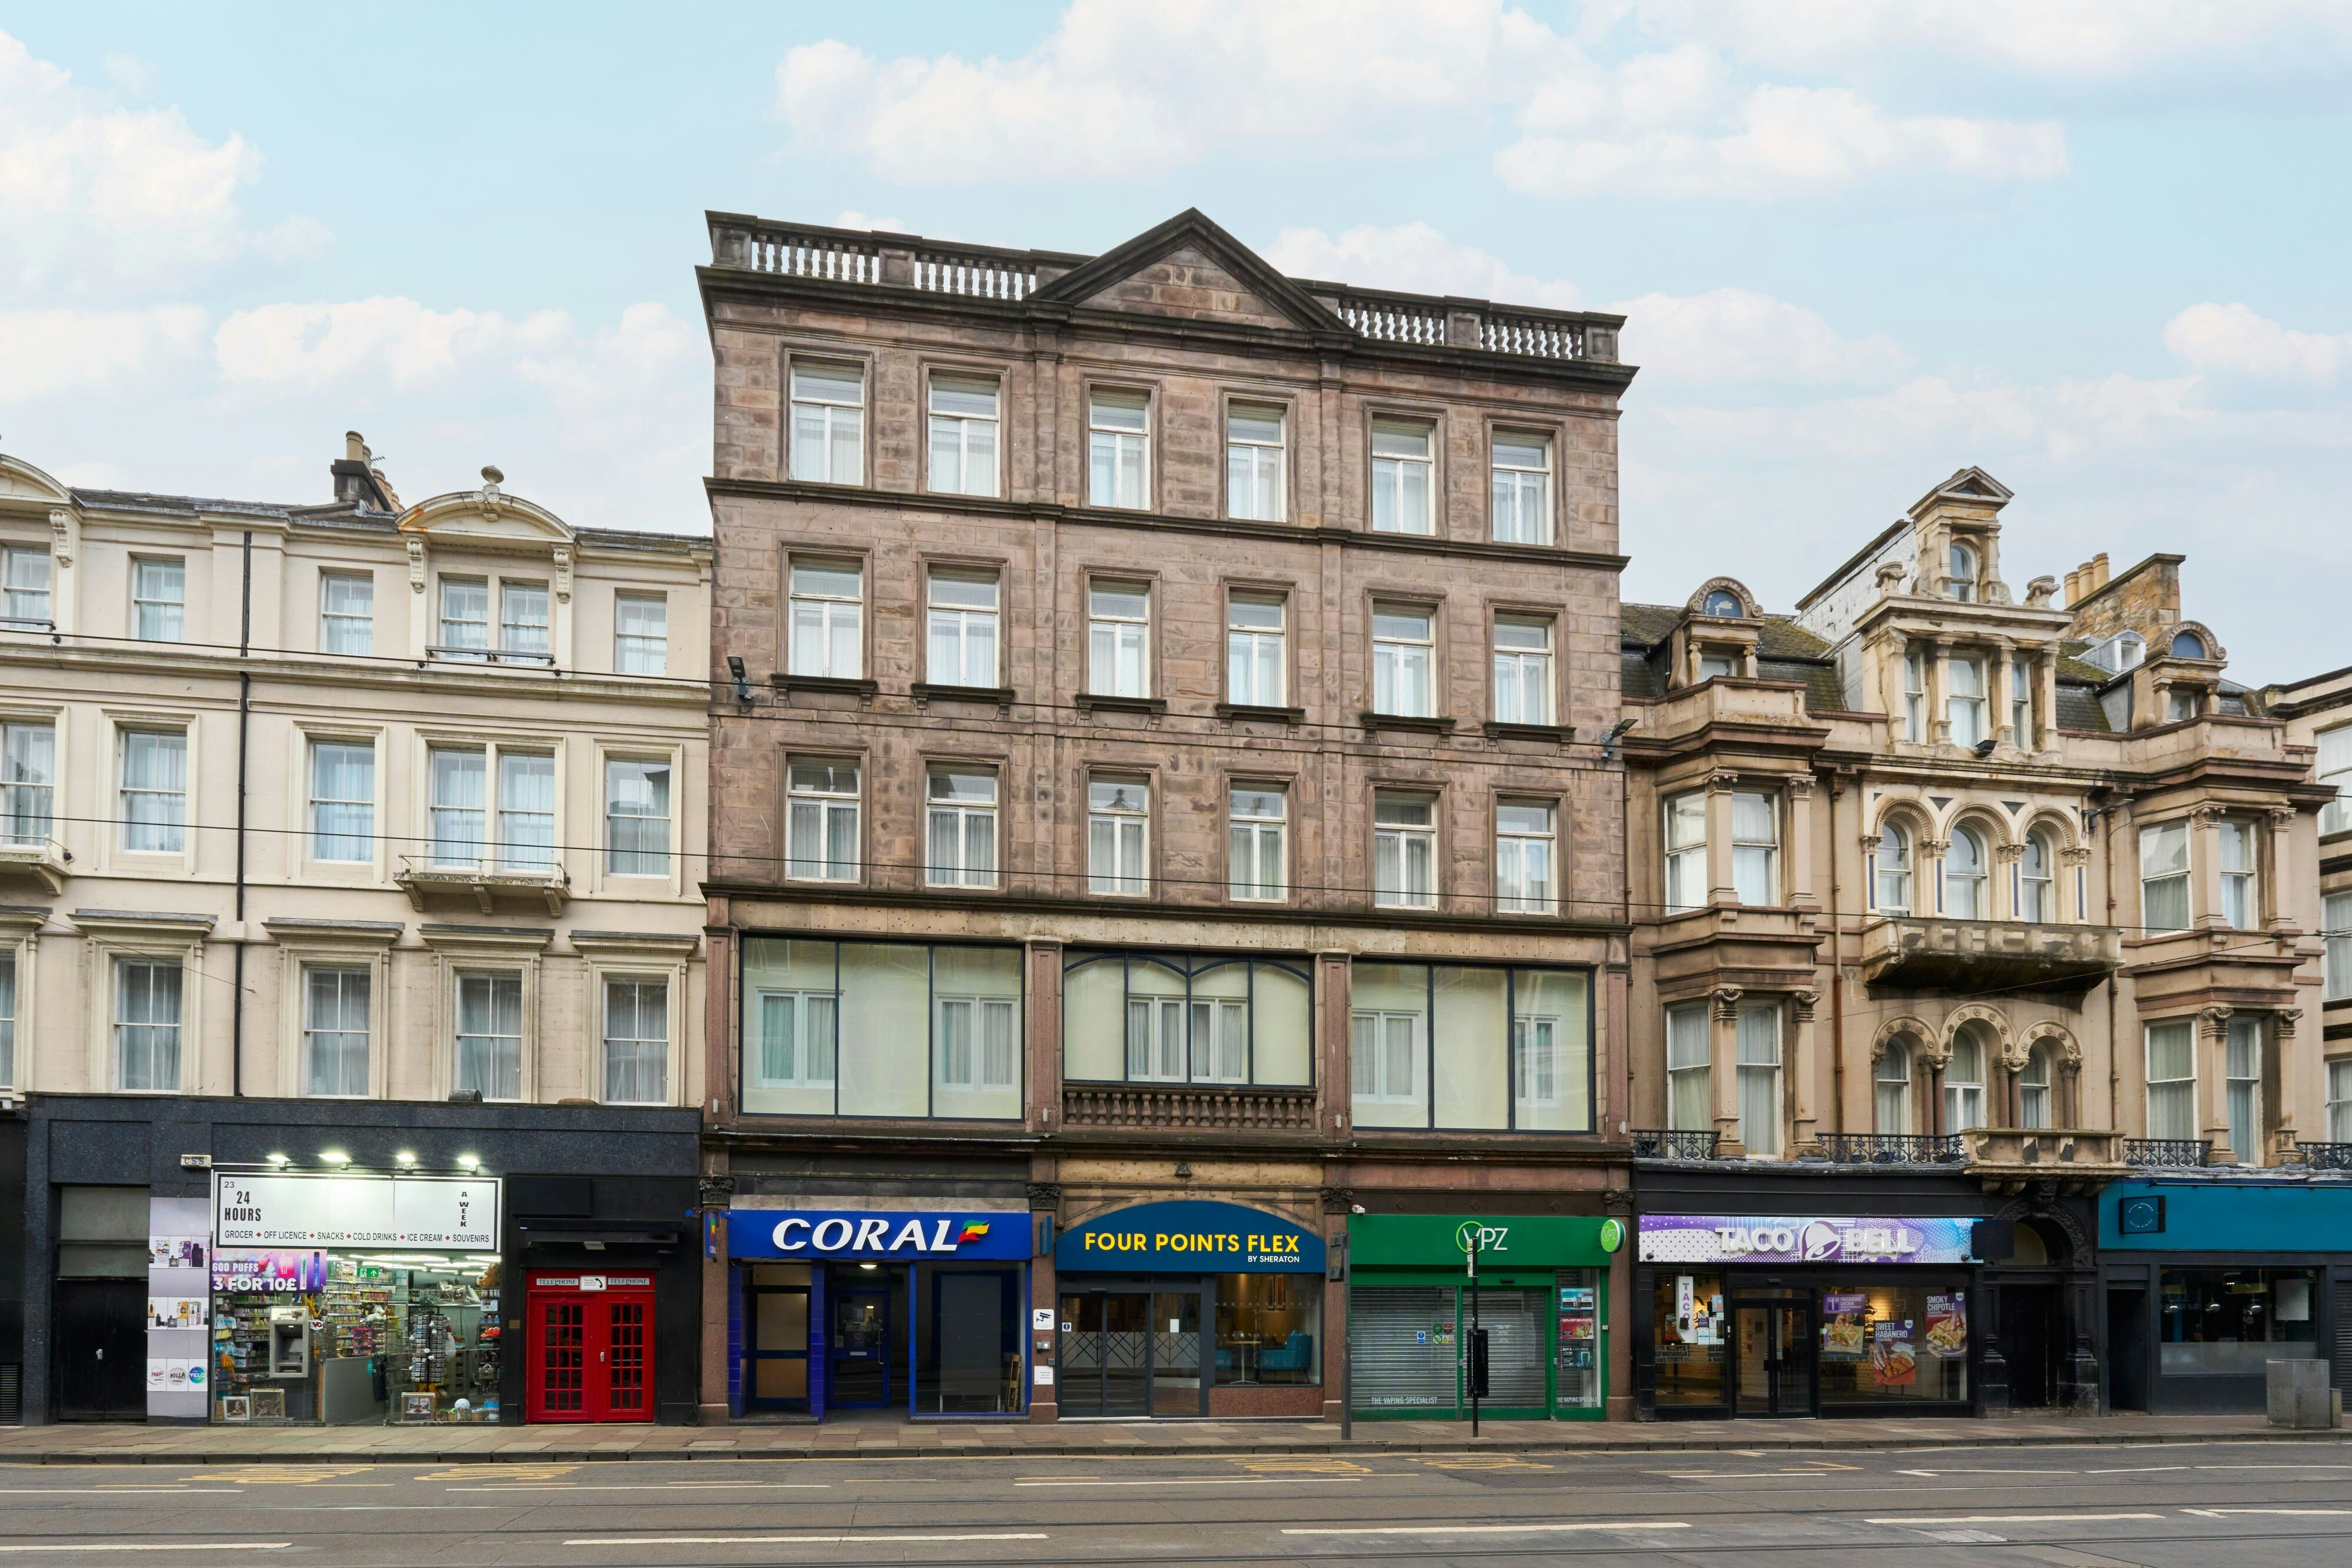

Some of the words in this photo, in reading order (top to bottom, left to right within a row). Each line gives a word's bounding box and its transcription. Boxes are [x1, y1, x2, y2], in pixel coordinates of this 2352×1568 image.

[236, 1191, 250, 1204] 24
[225, 1208, 261, 1222] HOURS
[459, 1202, 469, 1227] WEEK
[225, 1230, 253, 1239] GROCER
[279, 1231, 307, 1239] LICENCE
[353, 1232, 371, 1241] COLD
[373, 1233, 397, 1241] DRINKS
[419, 1233, 442, 1242] CREAM
[453, 1234, 489, 1242] SOUVENIRS
[772, 1218, 958, 1251] CORAL
[1715, 1227, 1794, 1252] TACO
[1846, 1228, 1916, 1252] BELL
[1085, 1233, 1147, 1251] FOUR
[1156, 1233, 1240, 1252] POINTS
[1248, 1235, 1299, 1252] FLEX
[212, 1263, 229, 1272] 600
[233, 1263, 259, 1272] PUFFS
[213, 1278, 223, 1290] 3
[228, 1278, 263, 1290] FOR
[267, 1278, 297, 1291] 10£
[1927, 1303, 1955, 1311] CHIPOTLE
